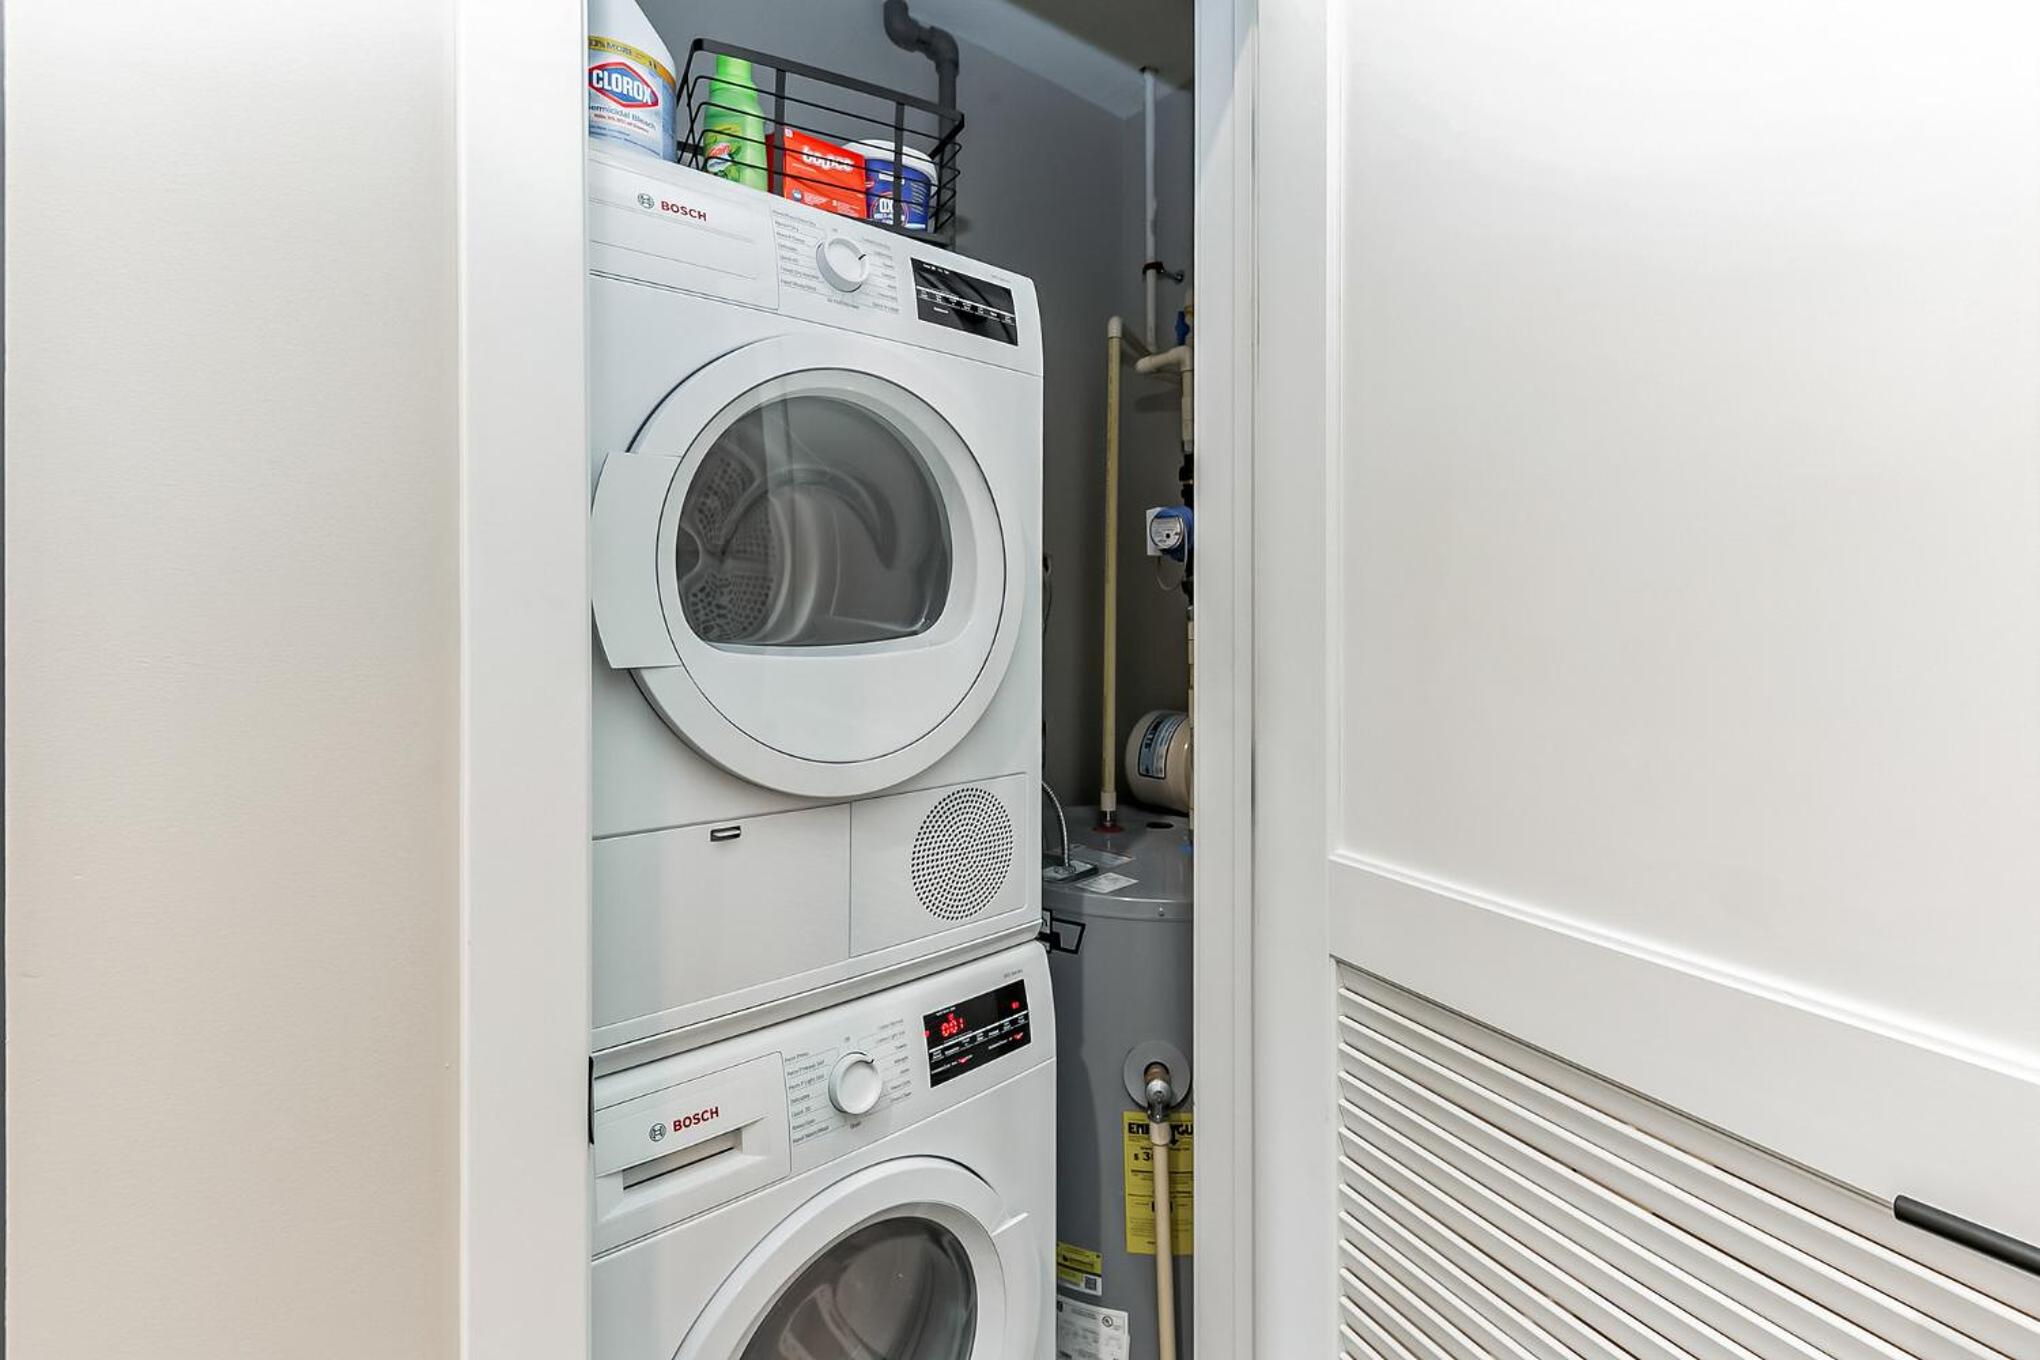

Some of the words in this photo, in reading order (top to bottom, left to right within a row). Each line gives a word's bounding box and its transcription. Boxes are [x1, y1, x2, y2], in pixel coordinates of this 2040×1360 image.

[592, 69, 652, 105] CLOROX
[589, 104, 630, 119] ermicidal
[660, 200, 707, 222] BOSCH
[672, 1106, 719, 1132] BOSCH
